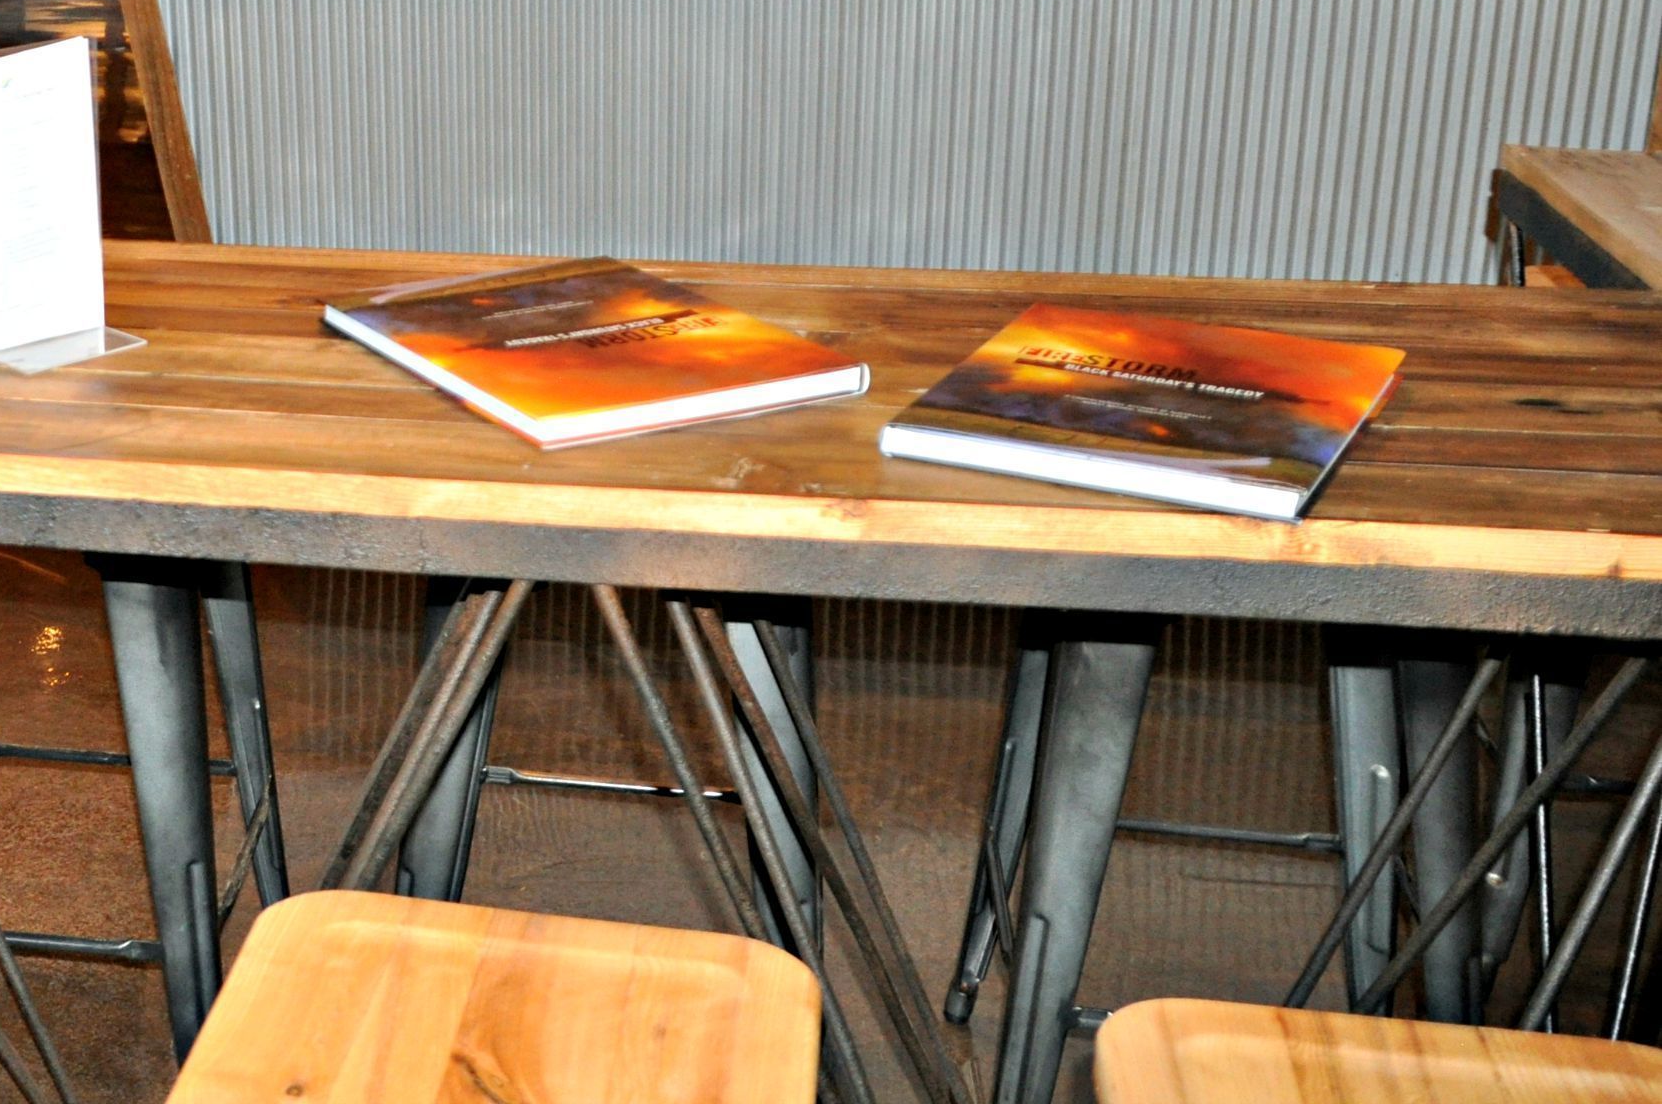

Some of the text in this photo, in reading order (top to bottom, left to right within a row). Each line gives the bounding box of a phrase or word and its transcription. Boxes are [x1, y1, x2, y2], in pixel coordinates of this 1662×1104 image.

[1018, 345, 1199, 380] FIRESTORM
[1063, 362, 1265, 399] BLACK SATURDAY'S TRAGEDY
